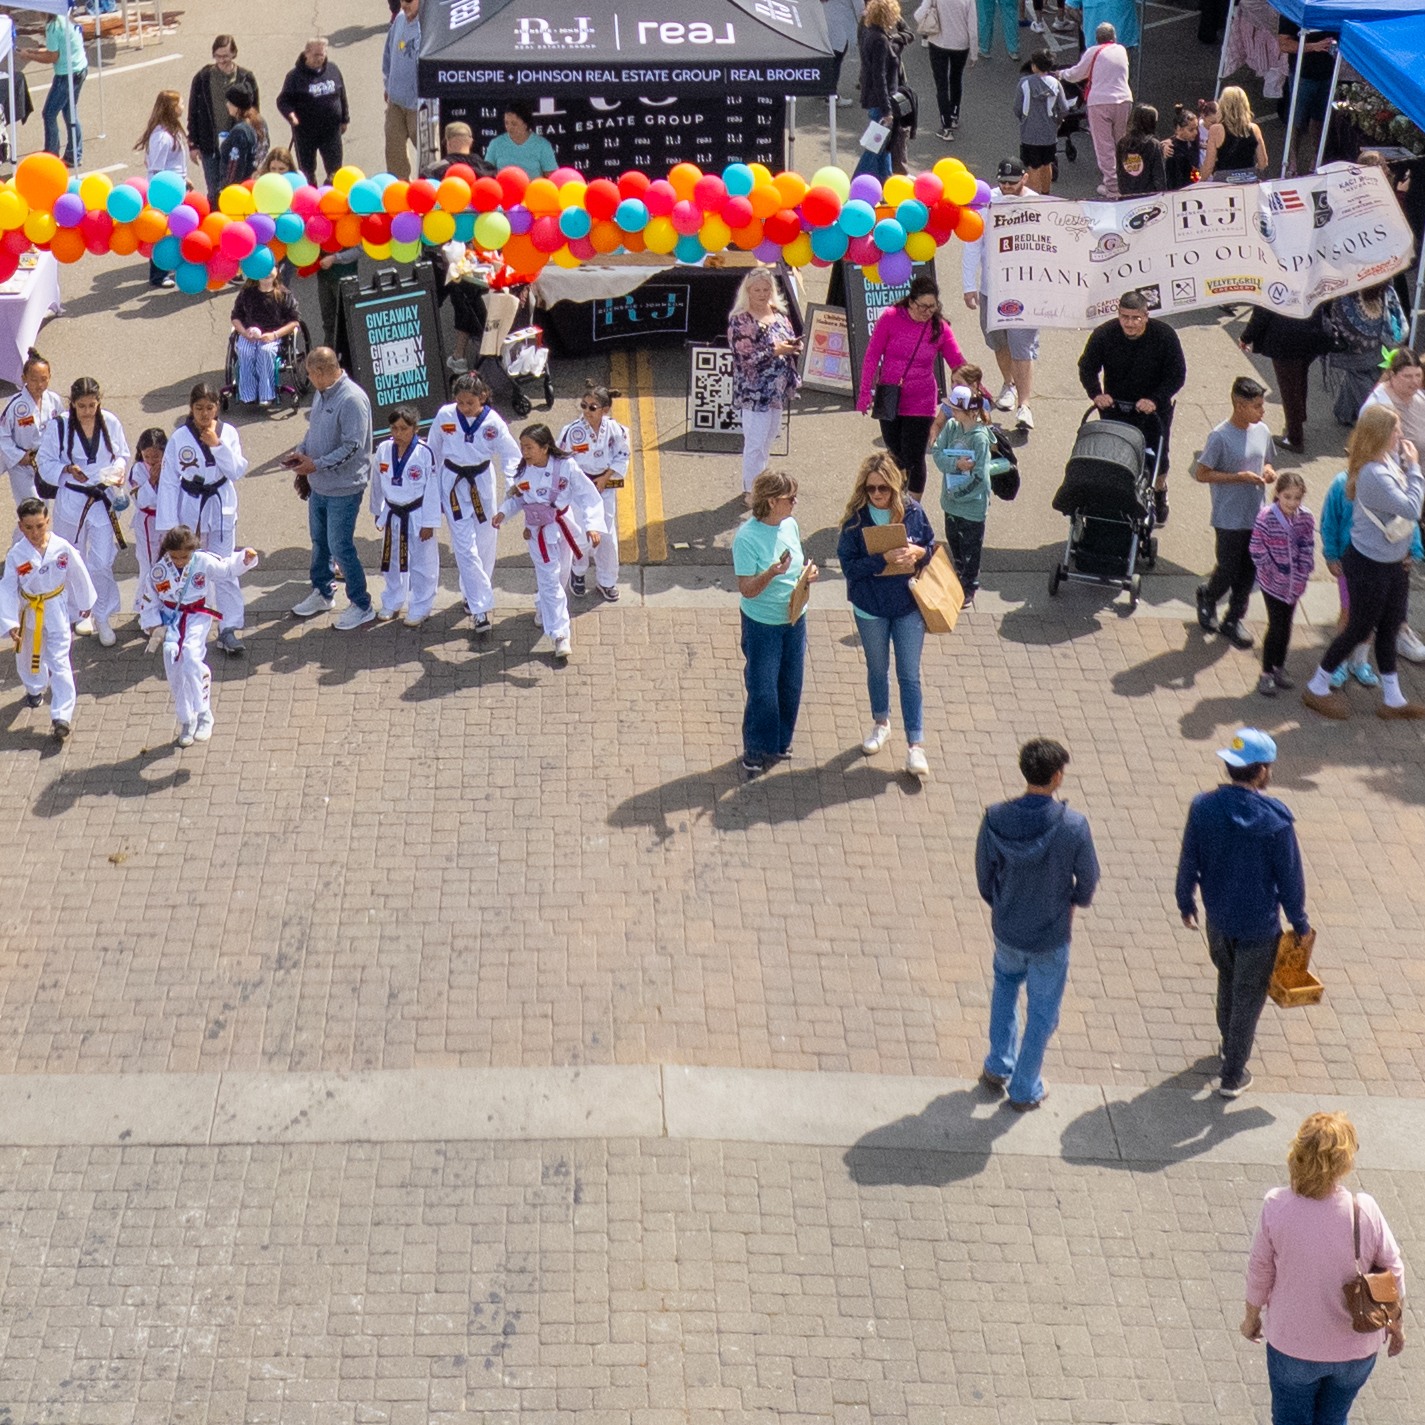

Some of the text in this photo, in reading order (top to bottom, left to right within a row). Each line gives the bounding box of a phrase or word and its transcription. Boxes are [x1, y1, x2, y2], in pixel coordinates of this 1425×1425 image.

[516, 17, 591, 45] RJ
[438, 70, 505, 83] ROENSPIE
[516, 70, 583, 85] JOHNSON
[585, 70, 620, 82] REAL
[622, 70, 670, 82] ESTATE
[672, 69, 722, 82] GROUP
[730, 69, 764, 82] REAL
[767, 68, 821, 81] BROKER
[530, 114, 705, 136] EAL ESTATE GROUP
[993, 210, 1042, 228] Frontier
[1179, 197, 1238, 229] RJ
[1014, 234, 1052, 243] REDLINE
[1014, 242, 1058, 253] BUILDERS
[1001, 266, 1089, 288] THANK
[1102, 257, 1152, 284] YOU
[1166, 250, 1200, 268] TO
[1215, 245, 1268, 264] OUR
[865, 289, 911, 306] GIVEAWA
[365, 304, 419, 329] GIVEAWAY
[1098, 304, 1120, 315] NEO
[368, 320, 421, 345] GIVEAWAY
[375, 366, 427, 391] GIVEAWAY
[377, 381, 429, 406] GIVEAWAY
